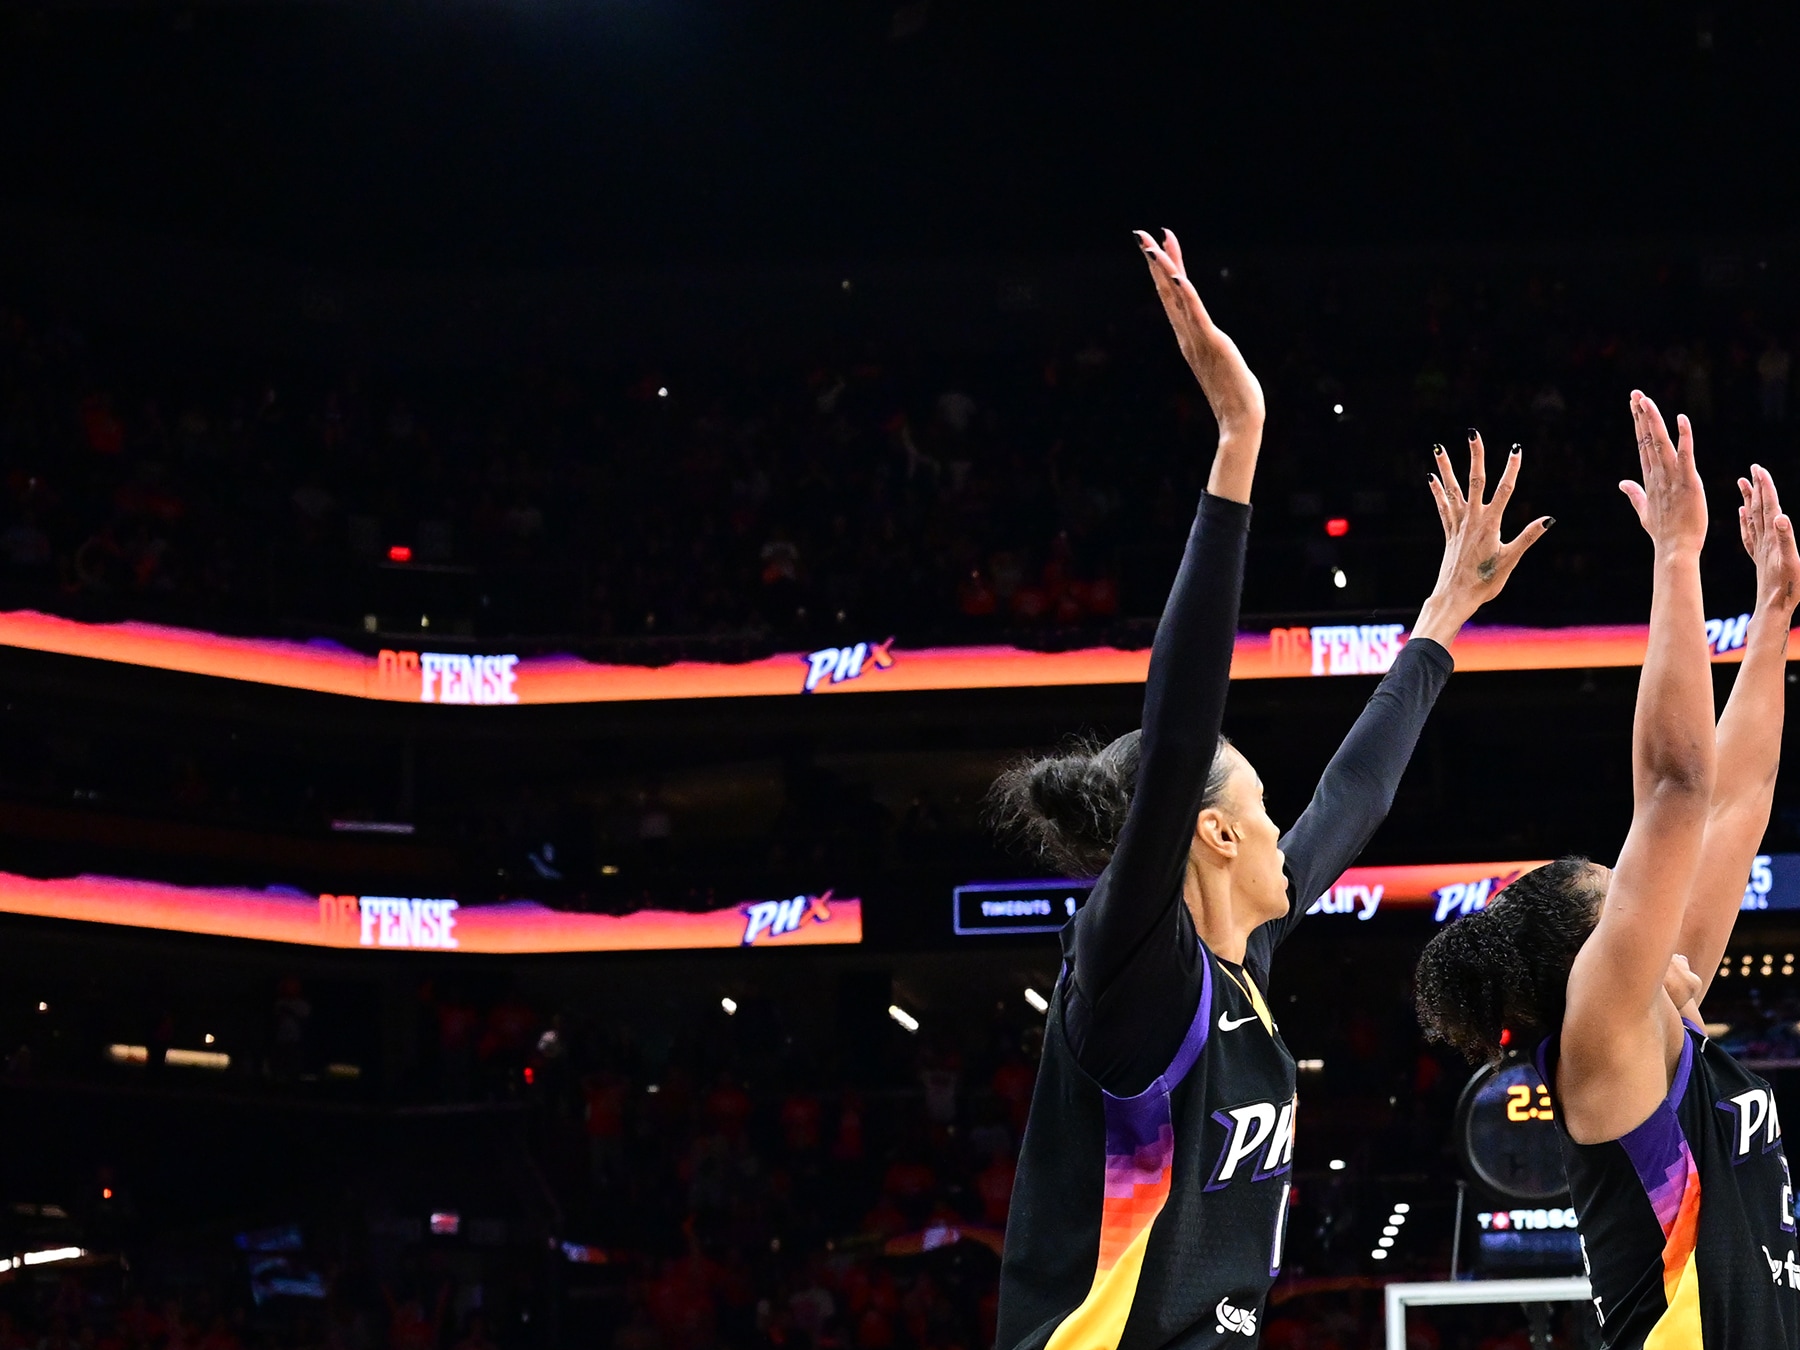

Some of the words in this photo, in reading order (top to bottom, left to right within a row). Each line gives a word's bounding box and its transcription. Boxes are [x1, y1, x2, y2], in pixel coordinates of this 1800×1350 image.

[1707, 613, 1750, 655] PH
[379, 649, 518, 704] DEFENSE
[803, 637, 895, 693] PHX
[319, 895, 458, 949] DEFENSE
[742, 889, 834, 946] PHX
[981, 900, 1051, 916] TIMEOUTS
[1210, 1100, 1296, 1187] PH
[1508, 1208, 1578, 1230] TISSO
